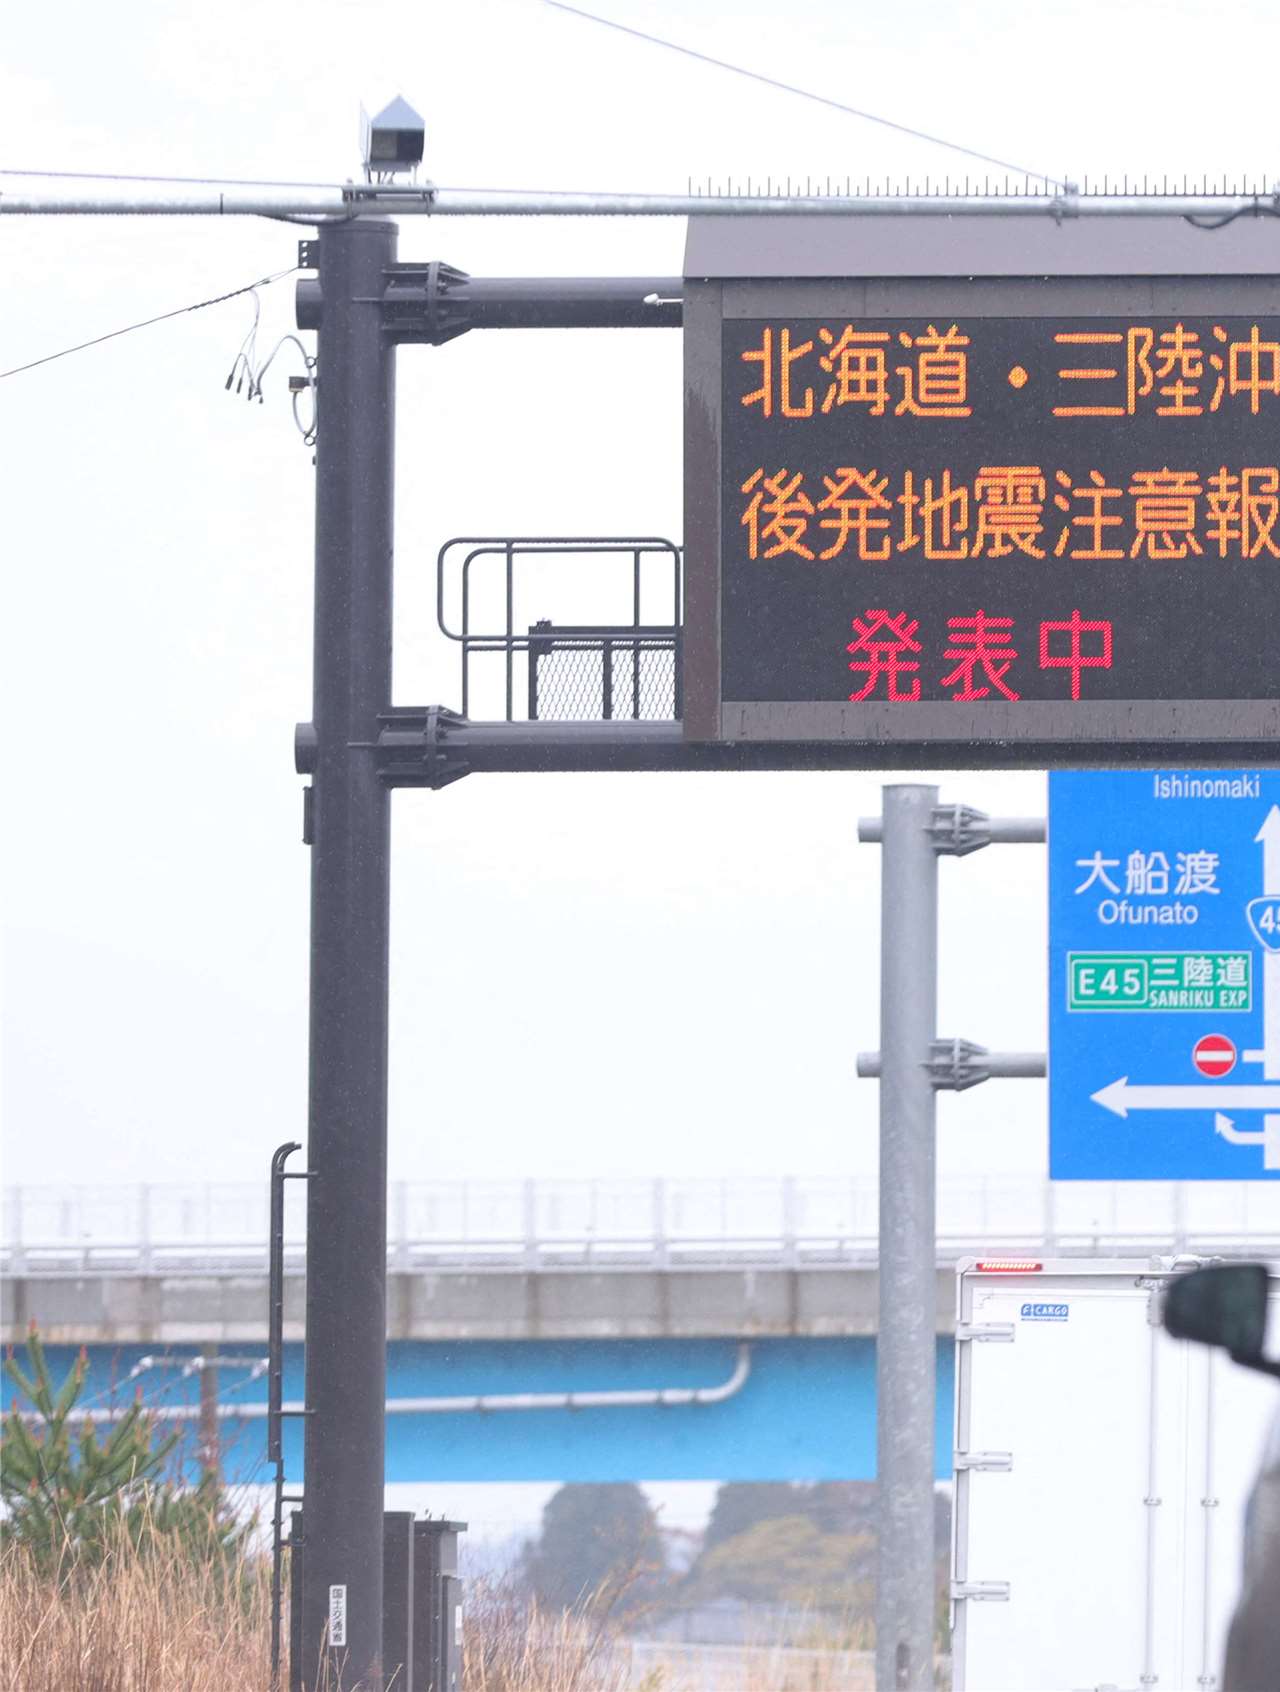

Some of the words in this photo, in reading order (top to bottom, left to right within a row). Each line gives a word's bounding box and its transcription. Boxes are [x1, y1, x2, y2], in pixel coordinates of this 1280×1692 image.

[740, 465, 1280, 561] 後発地震注意報
[847, 609, 1113, 701] 発表中
[1154, 775, 1260, 799] Ishinomaki
[1074, 850, 1221, 896] 大船渡
[1098, 899, 1199, 925] Ofunato
[1079, 968, 1141, 996] E45
[1149, 955, 1248, 988] 三陸道
[1149, 990, 1214, 1008] SANRIKU
[1218, 990, 1248, 1008] EXP
